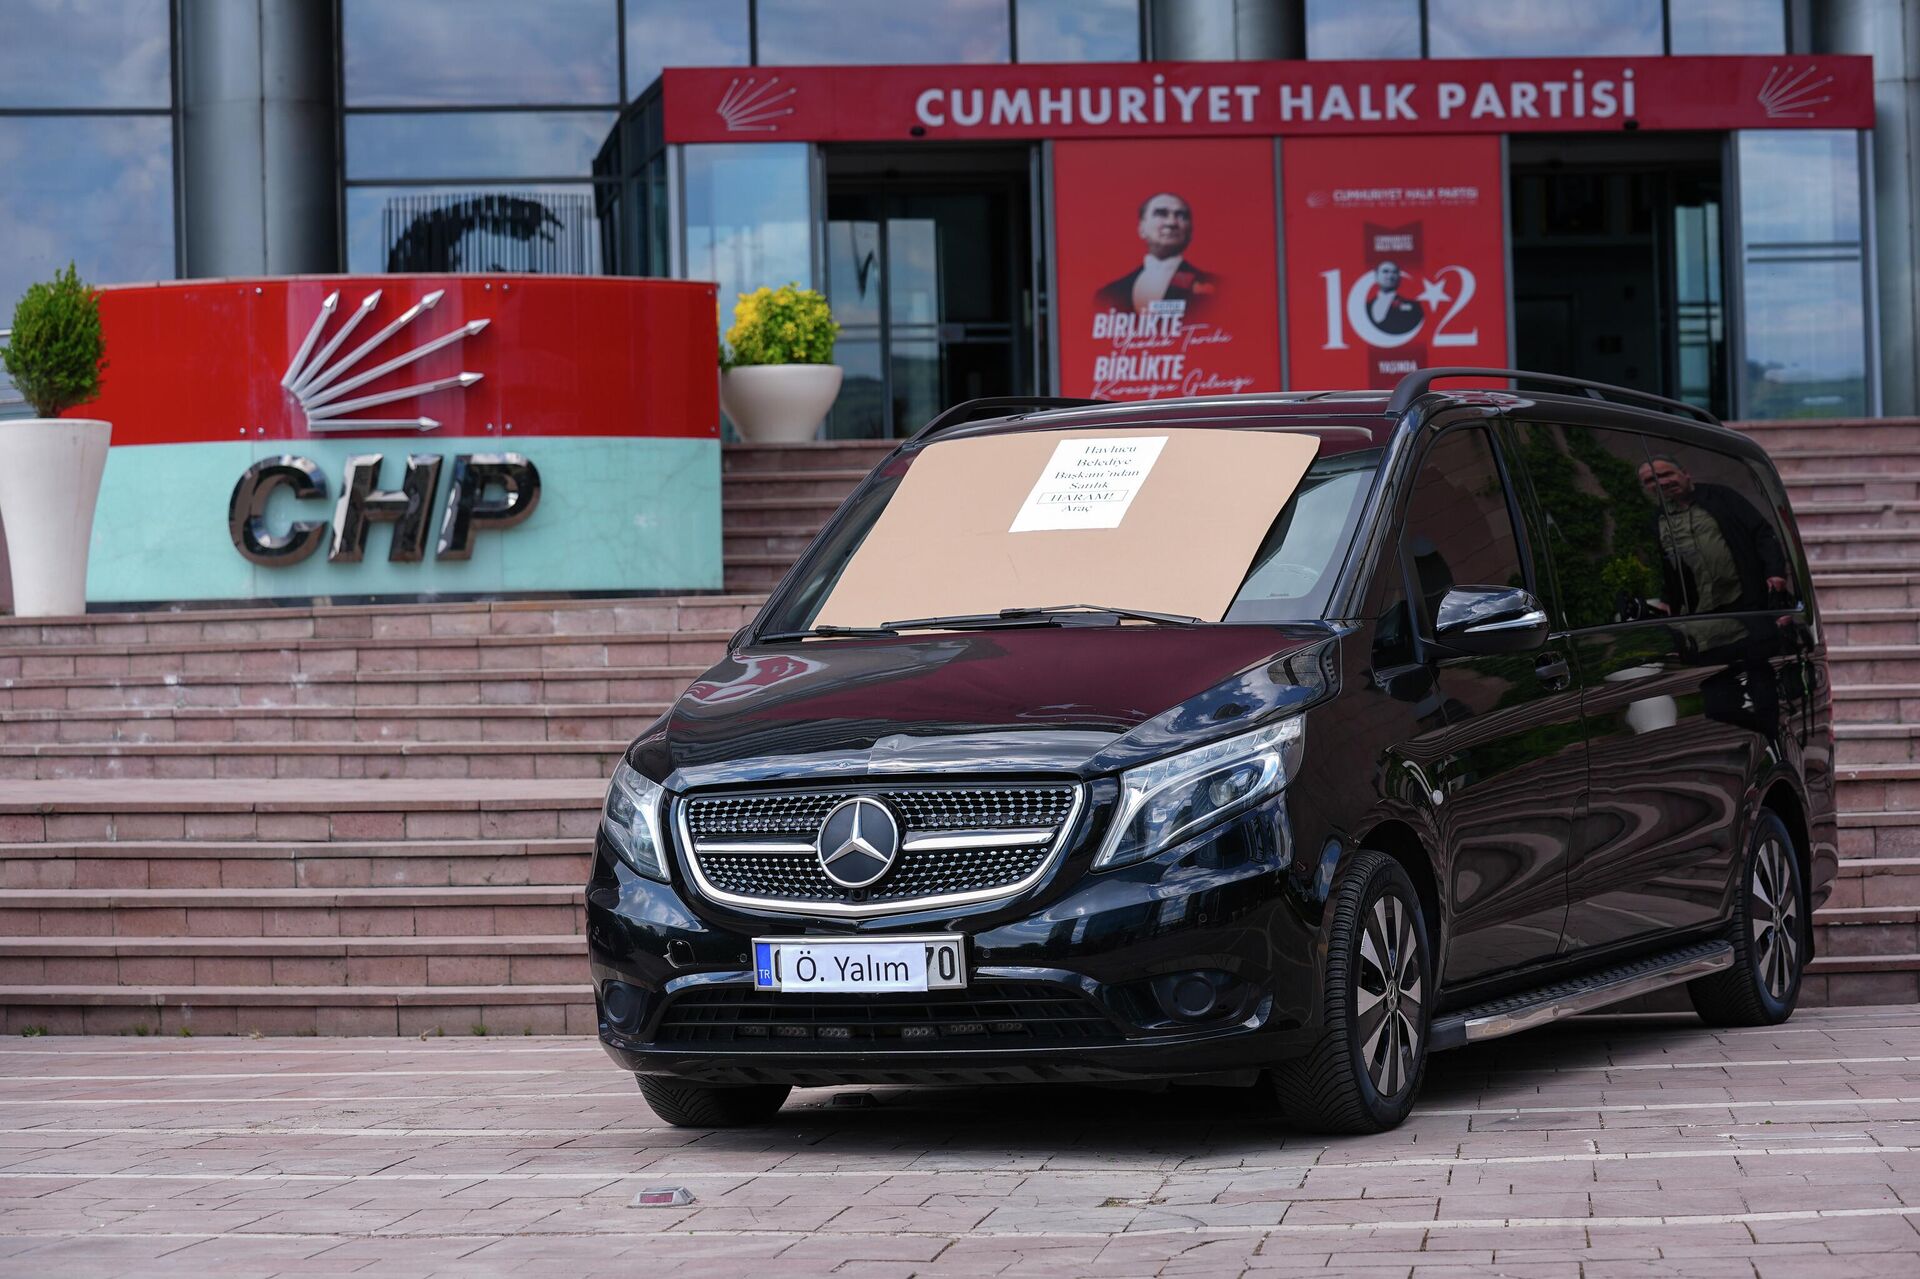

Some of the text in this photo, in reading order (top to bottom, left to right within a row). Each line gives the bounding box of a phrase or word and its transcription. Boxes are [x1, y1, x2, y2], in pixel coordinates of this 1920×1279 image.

[915, 69, 1635, 126] CUMHURİYET HALK PARTİSİ
[1092, 308, 1185, 339] BİRLİKTE
[1319, 265, 1478, 350] 102
[1093, 350, 1186, 382] BİRLİKTE
[1077, 458, 1132, 467] Belediye
[228, 452, 542, 567] CHP
[1051, 493, 1114, 502] HARAM!
[759, 969, 771, 980] TR
[796, 950, 825, 982] Ö.
[833, 954, 909, 982] Yalım
